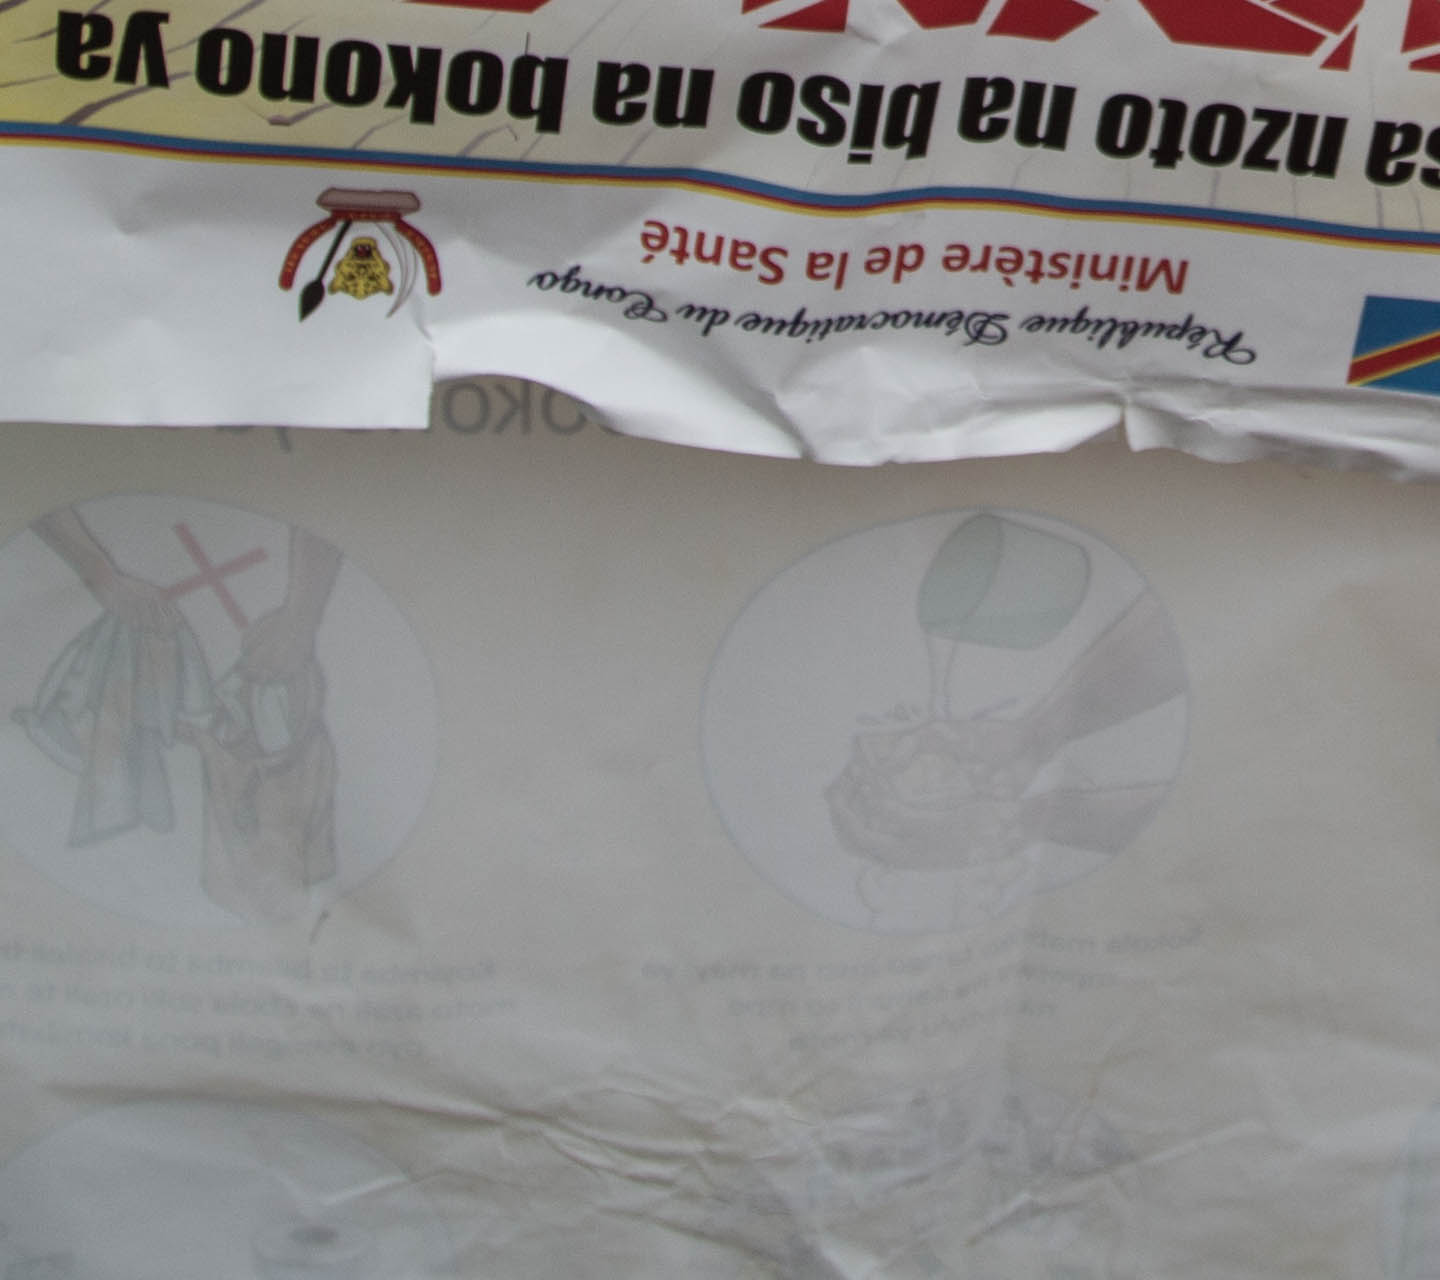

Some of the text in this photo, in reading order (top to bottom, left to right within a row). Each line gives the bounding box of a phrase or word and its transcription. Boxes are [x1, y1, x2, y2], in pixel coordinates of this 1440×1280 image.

[55, 10, 171, 90] ya
[193, 27, 568, 136] bokono
[592, 60, 715, 132] na
[735, 70, 941, 166] biso
[957, 76, 1077, 154] na
[1096, 92, 1348, 180] nzoto
[638, 219, 1189, 296] Ministère de la Santé
[525, 266, 1256, 366] République Démocratique du Congo
